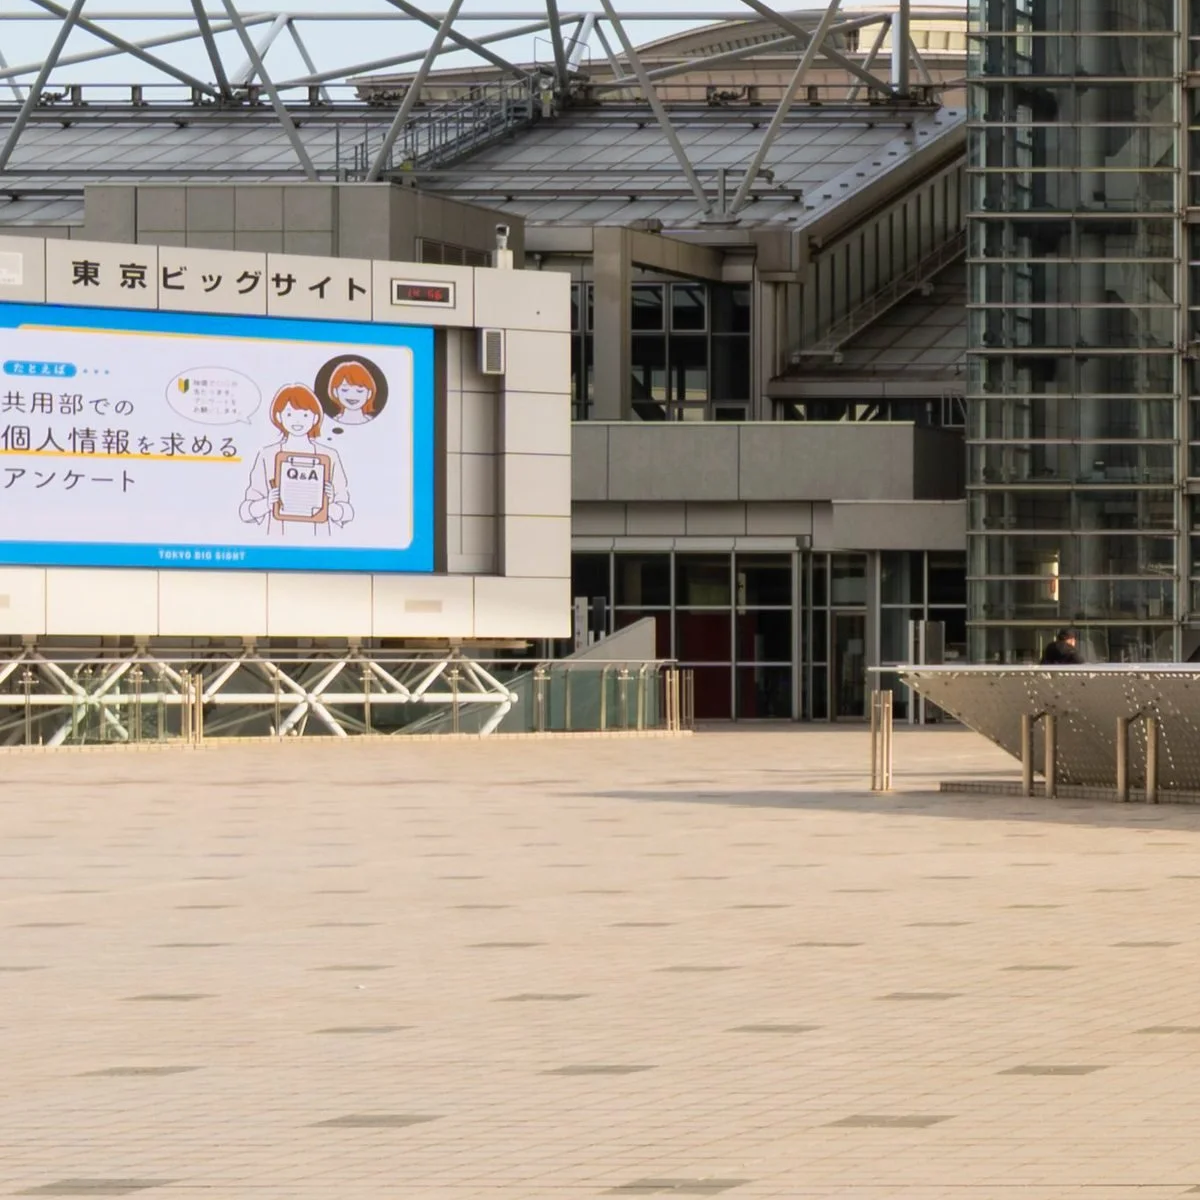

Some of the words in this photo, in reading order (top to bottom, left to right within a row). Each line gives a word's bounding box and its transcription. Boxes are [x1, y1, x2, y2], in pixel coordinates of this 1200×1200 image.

[71, 259, 367, 302] 東京ビッグサイト
[13, 363, 66, 375] たとえば
[2, 390, 134, 416] 共用部での
[1, 424, 238, 458] 個人情報を求める
[4, 468, 135, 492] アンケート
[287, 468, 318, 481] Q&A
